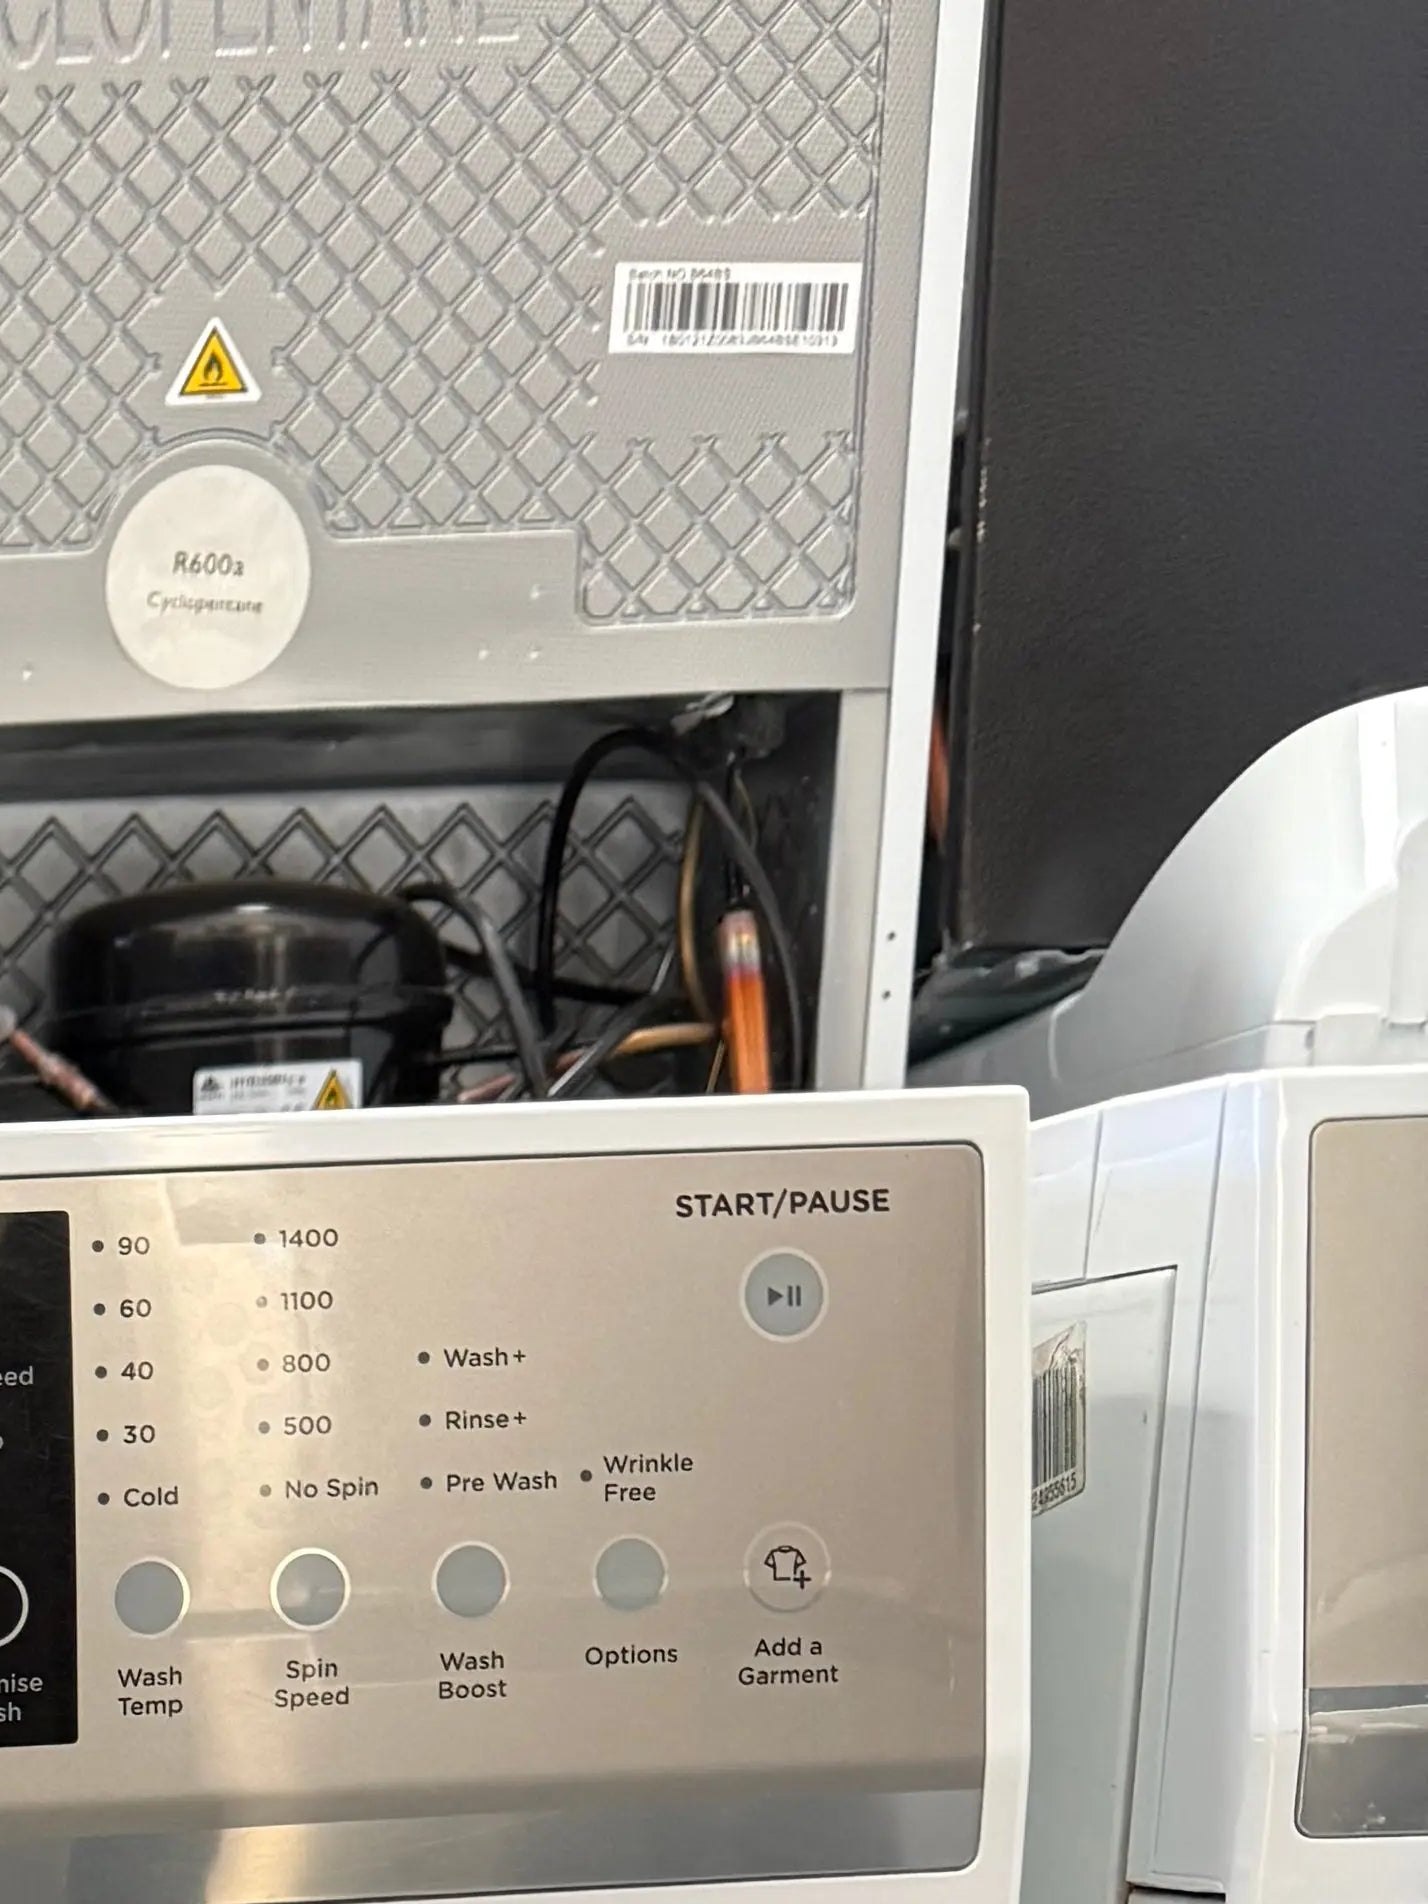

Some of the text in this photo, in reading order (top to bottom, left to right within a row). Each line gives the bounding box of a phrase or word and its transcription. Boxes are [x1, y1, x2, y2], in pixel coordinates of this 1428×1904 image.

[677, 1189, 889, 1218] START/PAUSE
[119, 1237, 149, 1255] 90
[280, 1229, 338, 1247] 1400
[120, 1299, 151, 1318] 60
[281, 1291, 333, 1310] 1100
[283, 1353, 330, 1372] 800
[444, 1347, 525, 1367] Wash+
[121, 1362, 153, 1380] 40
[285, 1416, 331, 1435] 500
[446, 1411, 526, 1429] Rinse+
[124, 1425, 155, 1443] 30
[604, 1453, 693, 1473] Wrinkle
[286, 1477, 378, 1500] No Spin
[447, 1471, 556, 1492] Pre Wash
[124, 1486, 178, 1507] Cold
[605, 1484, 655, 1502] Free
[755, 1638, 822, 1656] Add a
[440, 1651, 504, 1671] Wash
[586, 1647, 677, 1668] Options
[118, 1666, 181, 1687] Wash
[287, 1658, 337, 1681] Spin
[739, 1666, 838, 1685] Garment
[276, 1686, 349, 1711] Speed
[439, 1680, 506, 1699] Boost
[118, 1698, 182, 1717] Temp
